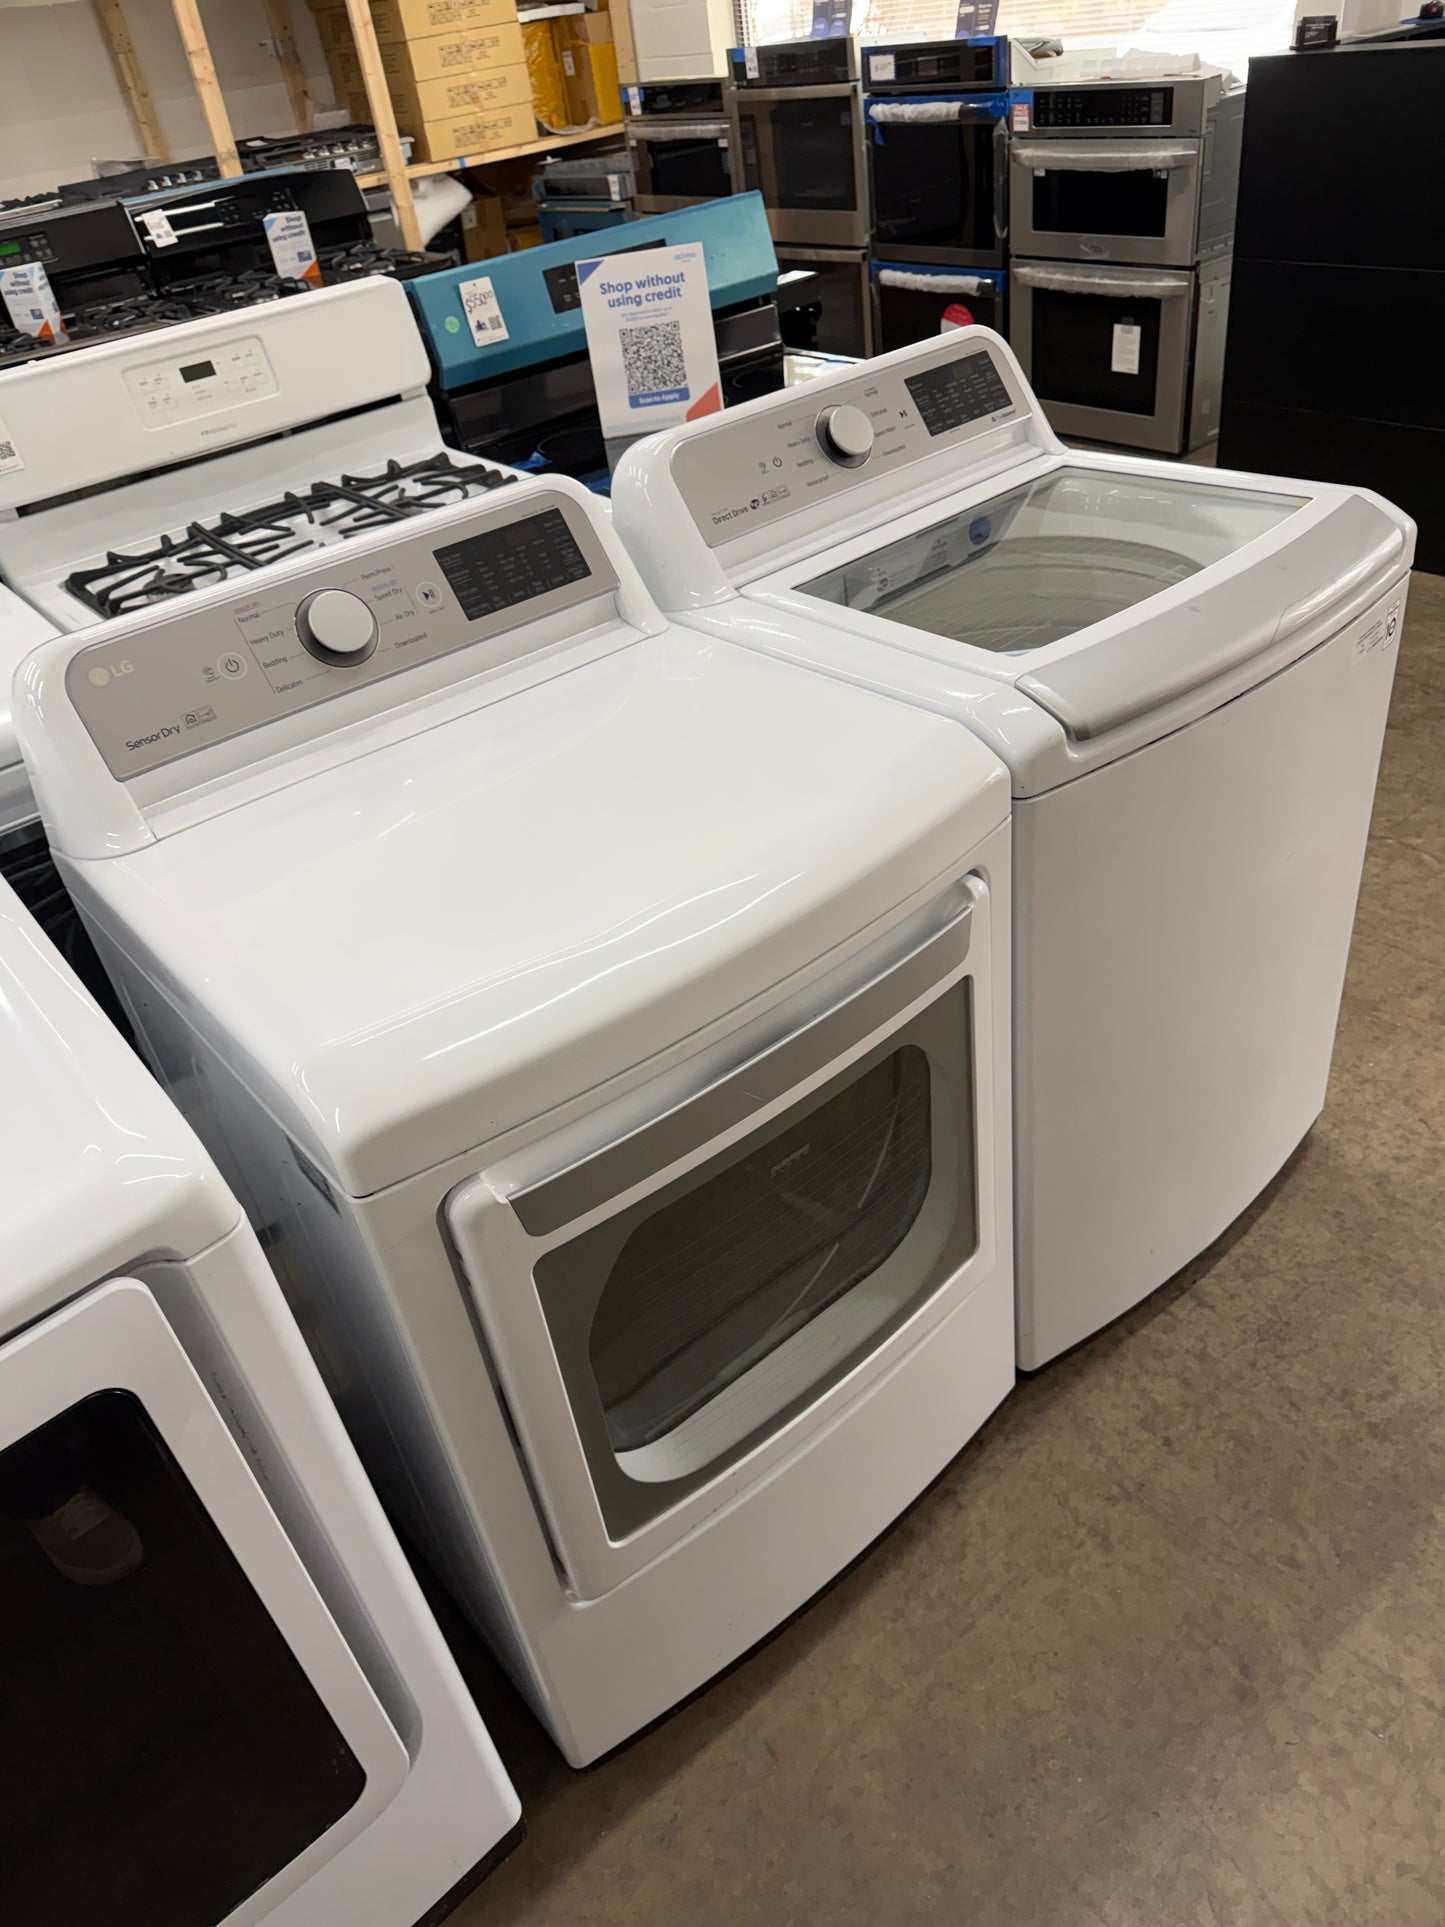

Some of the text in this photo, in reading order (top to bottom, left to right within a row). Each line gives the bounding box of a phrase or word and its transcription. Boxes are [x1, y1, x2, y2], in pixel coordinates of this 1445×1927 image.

[599, 271, 686, 296] Shop without
[607, 287, 682, 309] using credit
[662, 392, 680, 402] Apply
[712, 512, 733, 526] Direct
[732, 505, 750, 518] Drive
[374, 588, 391, 603] Speed
[391, 585, 404, 599] Dry
[237, 612, 261, 625] Normal
[405, 608, 416, 620] Dry
[250, 628, 285, 647] Heavy Duty
[394, 632, 428, 648] Downloaded
[110, 660, 135, 677] LG
[262, 656, 288, 671] Bedding
[275, 679, 304, 694] Delicates
